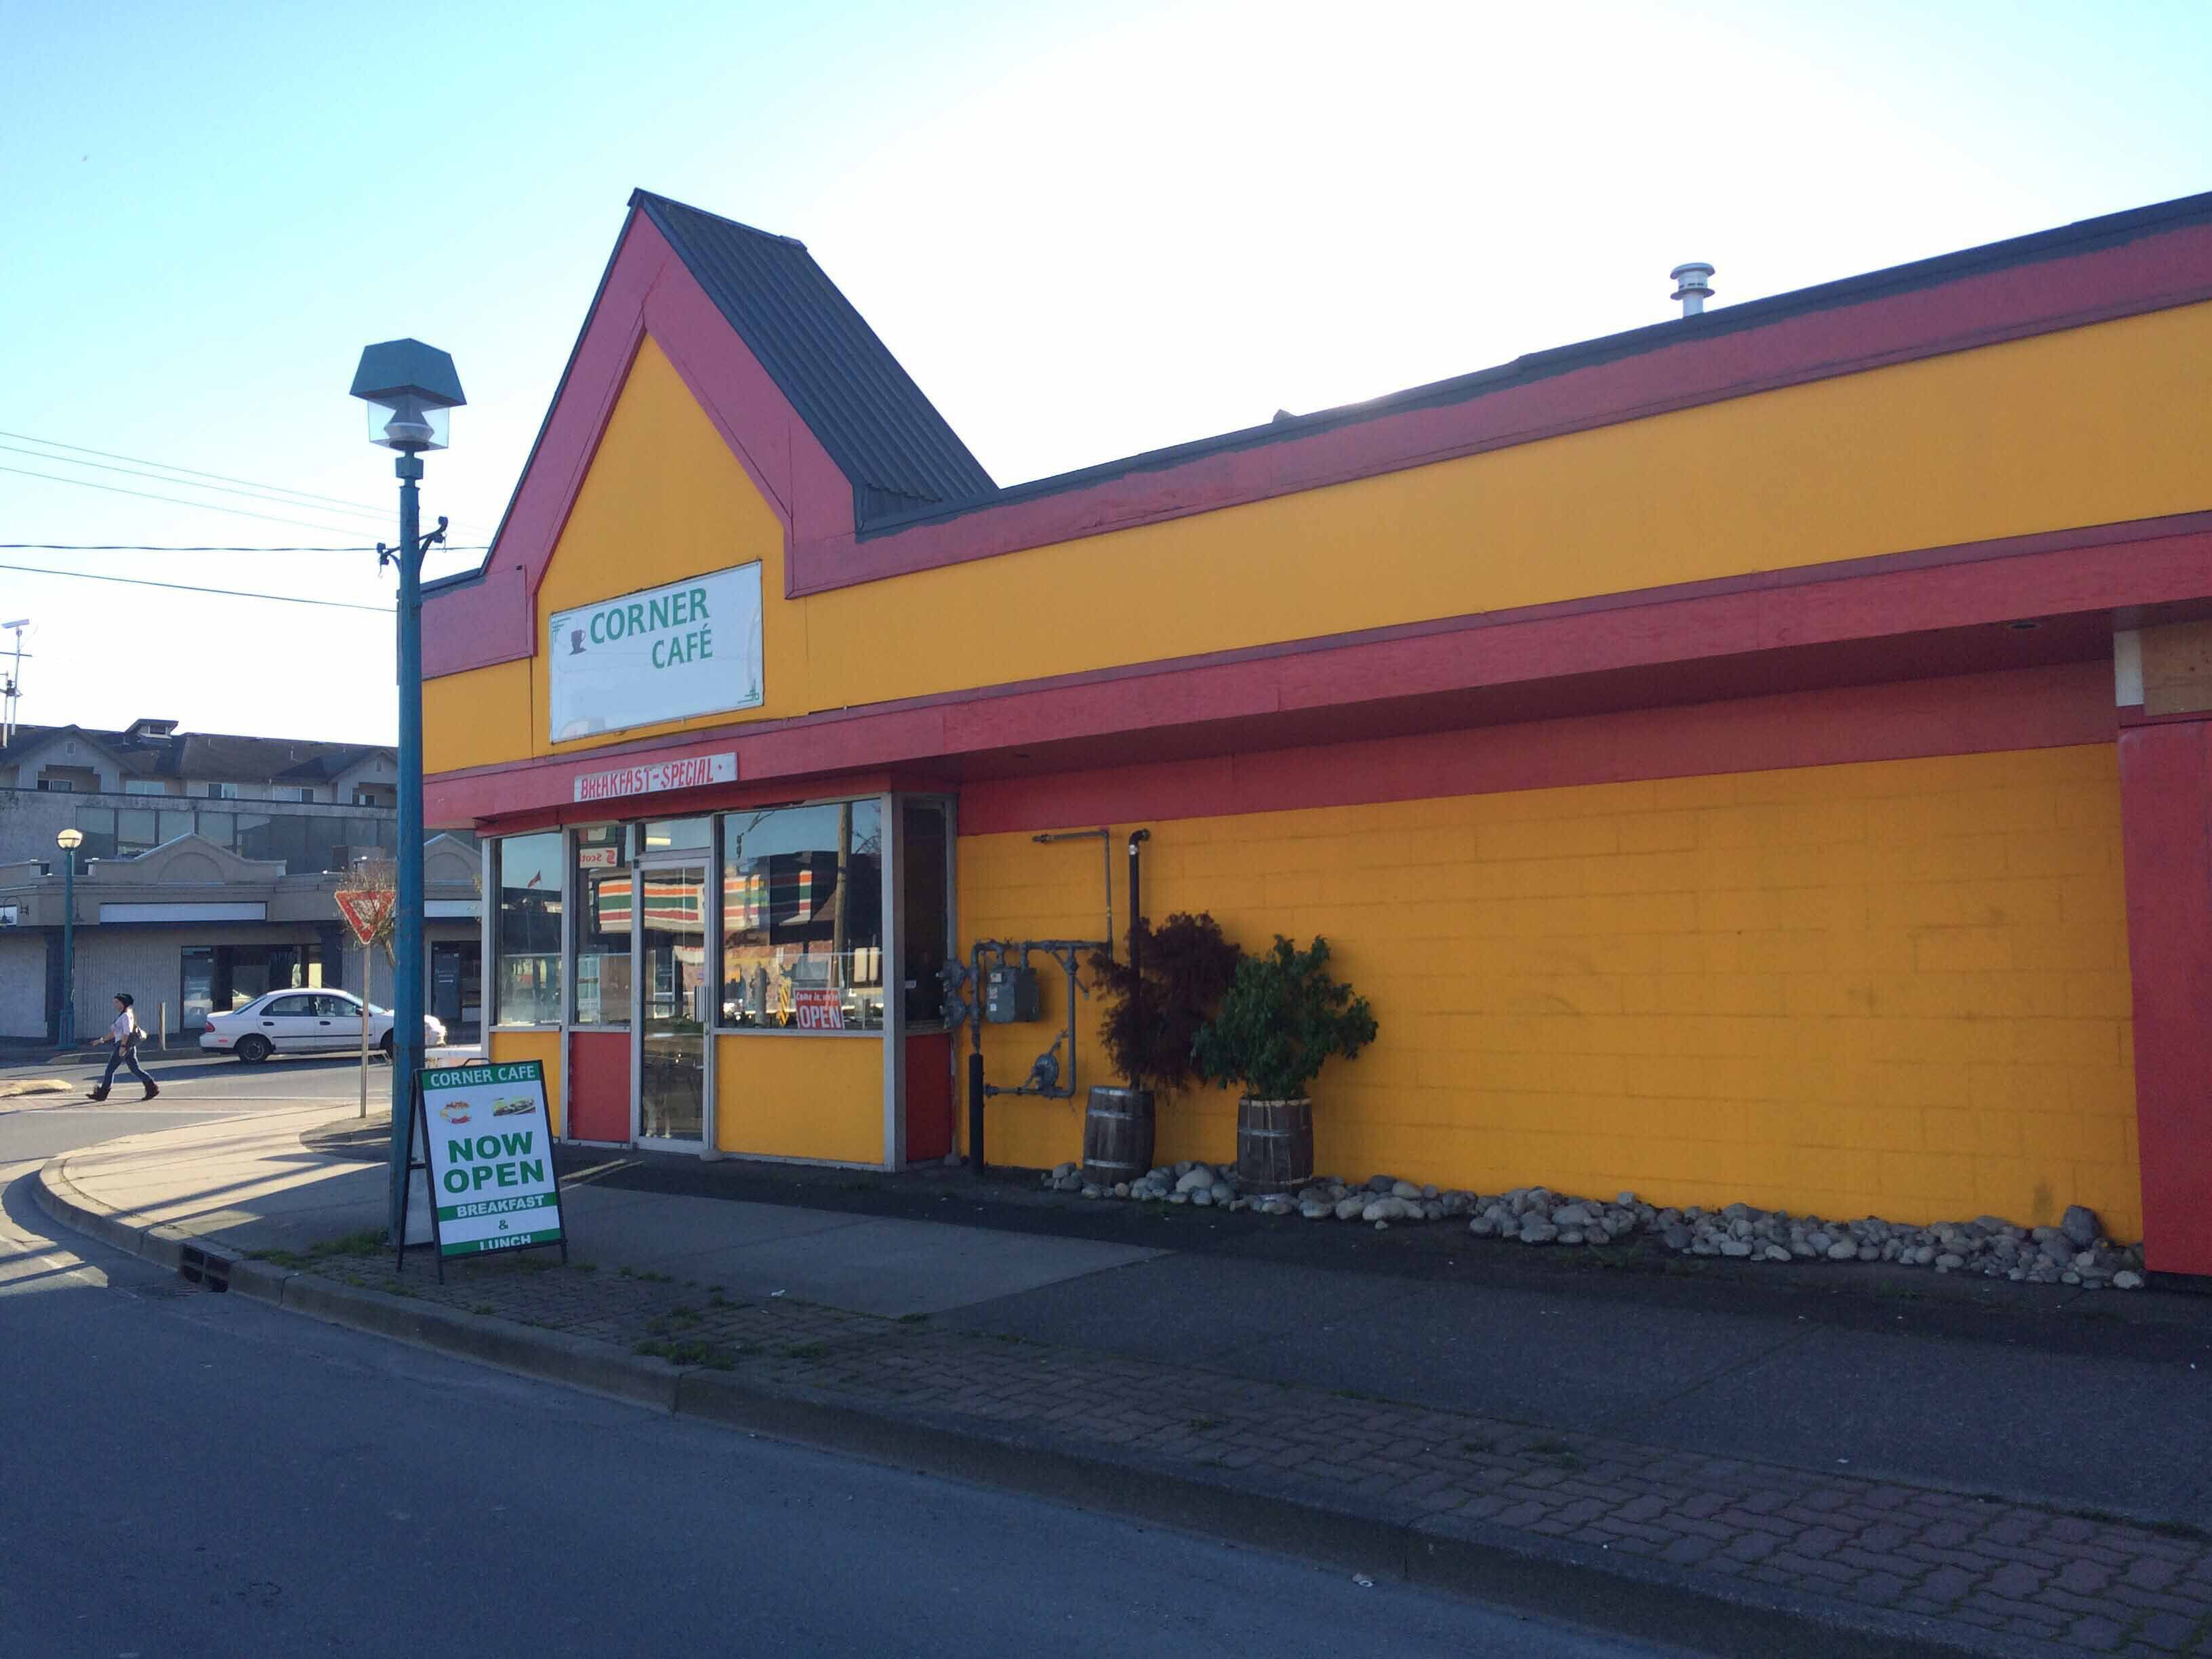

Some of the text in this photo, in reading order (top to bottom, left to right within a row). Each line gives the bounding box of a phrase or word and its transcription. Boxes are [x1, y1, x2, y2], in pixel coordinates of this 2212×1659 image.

[590, 588, 710, 644] CORNER
[652, 623, 713, 669] CAFÉ
[799, 1005, 842, 1029] OPEN
[430, 1065, 535, 1087] CORNER CAFE
[447, 1131, 533, 1164] NOW
[443, 1159, 545, 1193] OPEN
[456, 1195, 545, 1218] BREAKFAST
[499, 1219, 509, 1231] &
[480, 1234, 532, 1251] LUNCH
